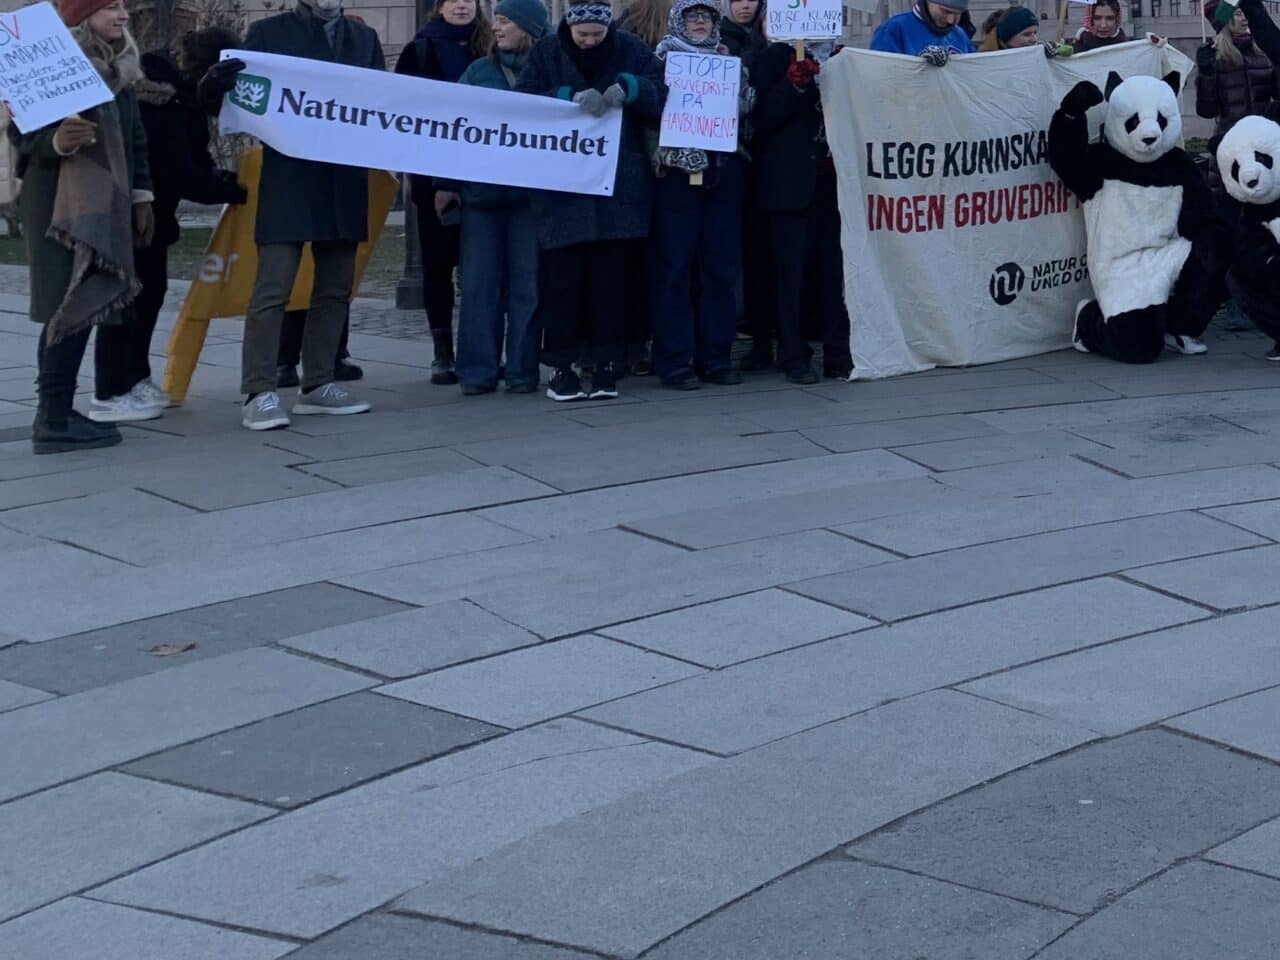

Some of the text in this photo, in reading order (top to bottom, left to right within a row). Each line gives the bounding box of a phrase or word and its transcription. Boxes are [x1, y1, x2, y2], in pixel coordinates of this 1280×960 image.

[667, 55, 737, 81] STOPP
[276, 87, 609, 157] Naturvernforbundet
[865, 129, 1050, 180] LEGG KUNNSKA
[866, 180, 1080, 234] INGEN GRUVEDRIF
[1032, 256, 1077, 279] NATUR
